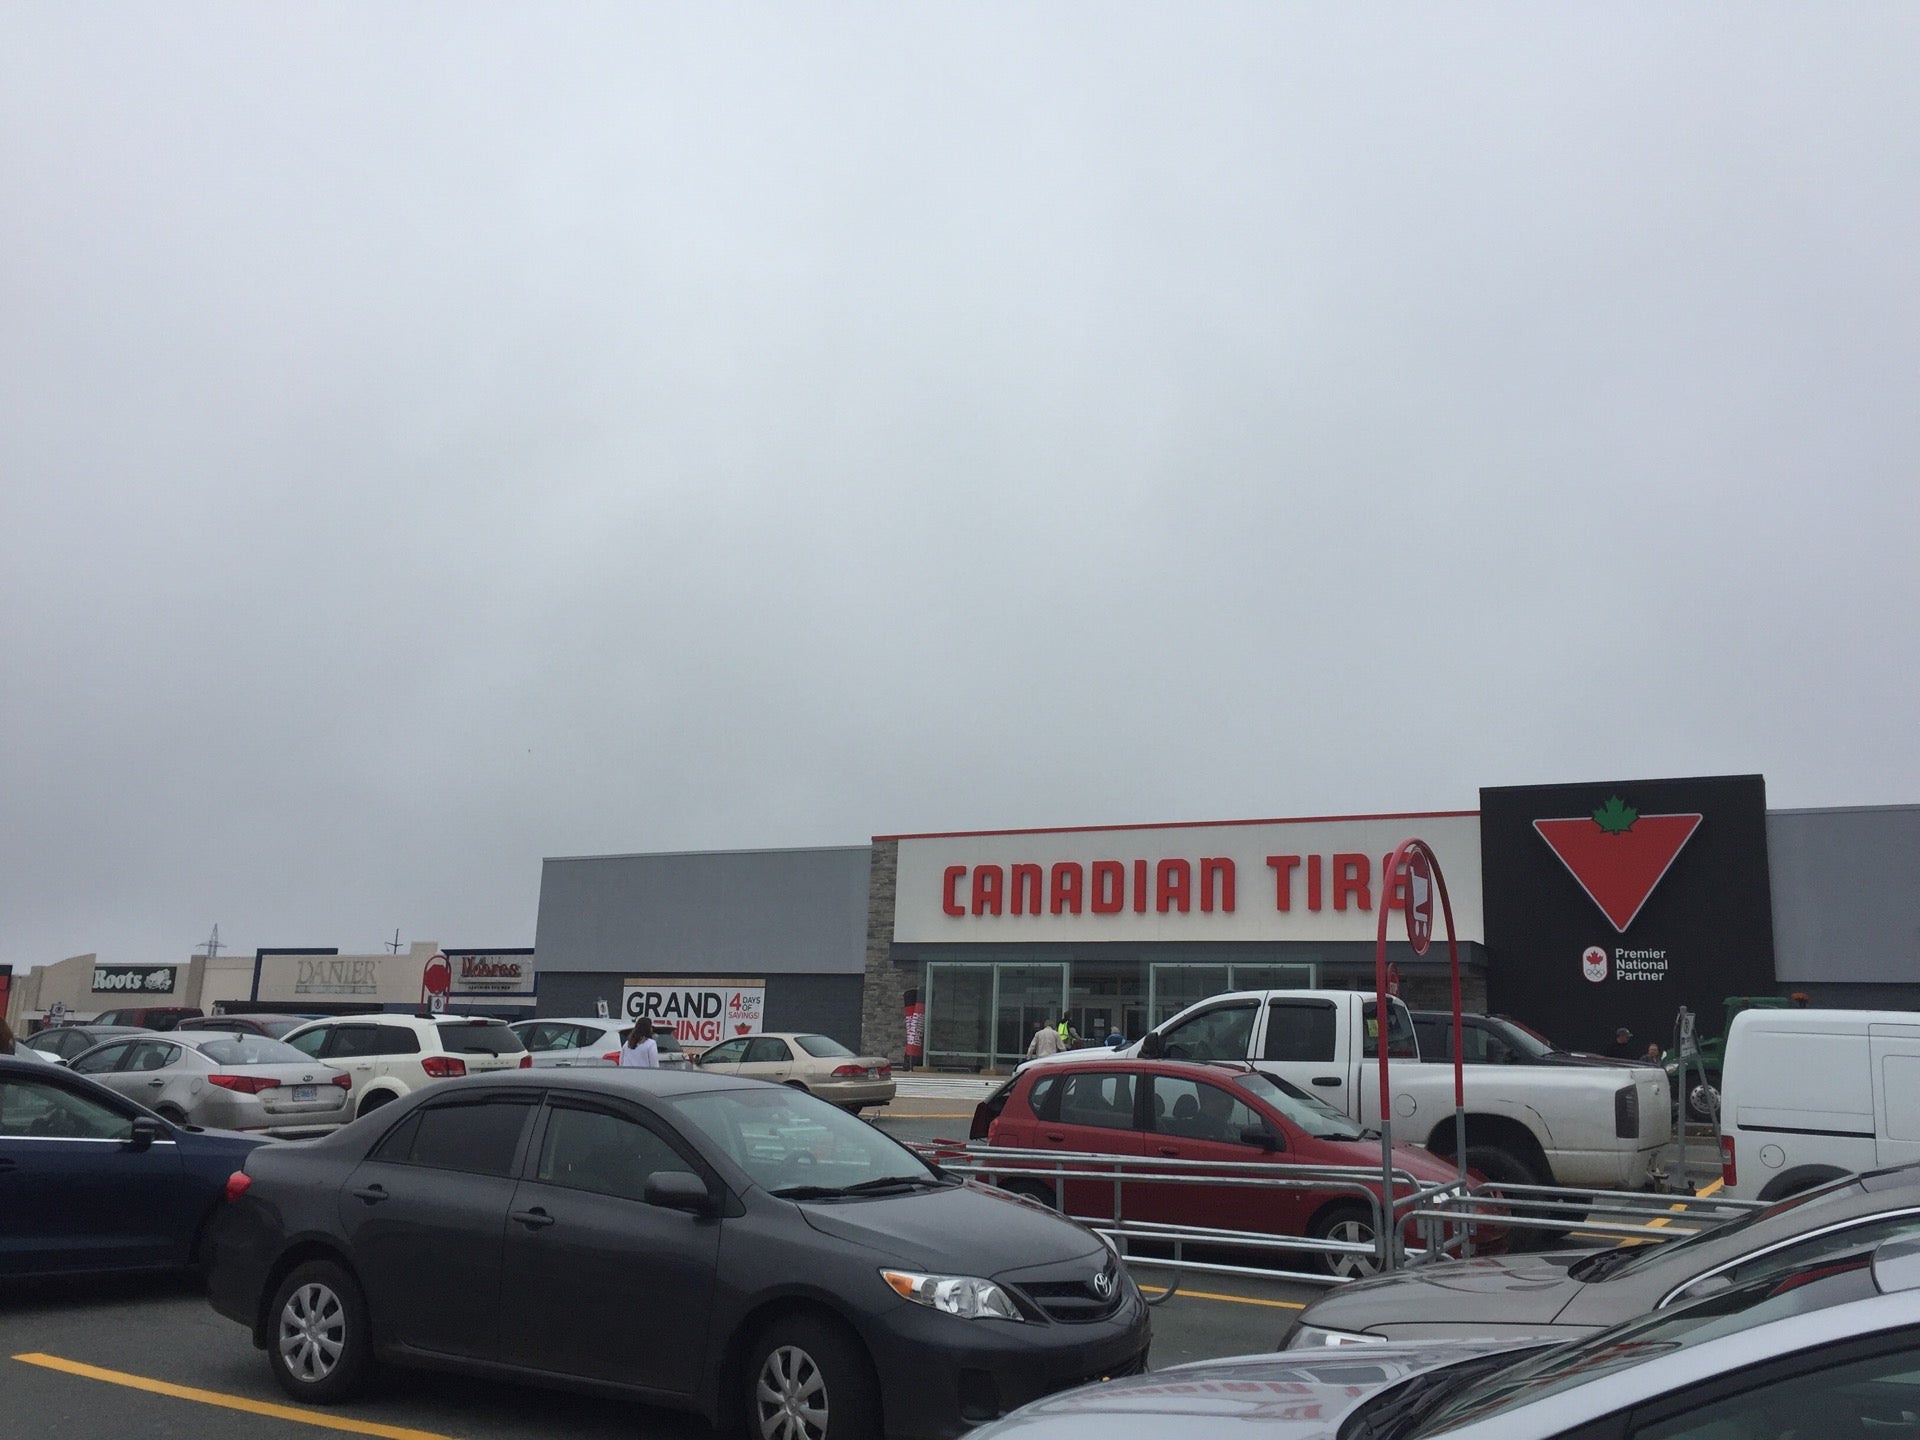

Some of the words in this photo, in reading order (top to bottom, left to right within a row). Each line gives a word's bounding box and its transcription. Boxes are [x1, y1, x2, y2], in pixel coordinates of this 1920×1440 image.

[943, 857, 1236, 917] CANADIAN
[1615, 948, 1667, 959] Premier
[1616, 959, 1669, 970] National
[93, 969, 143, 989] Roots
[1616, 970, 1665, 981] Partner
[626, 991, 722, 1019] GRAND
[729, 992, 742, 1011] 4
[742, 996, 761, 1004] DAYS
[742, 1004, 752, 1012] OF
[728, 1011, 760, 1019] SAVINGS!
